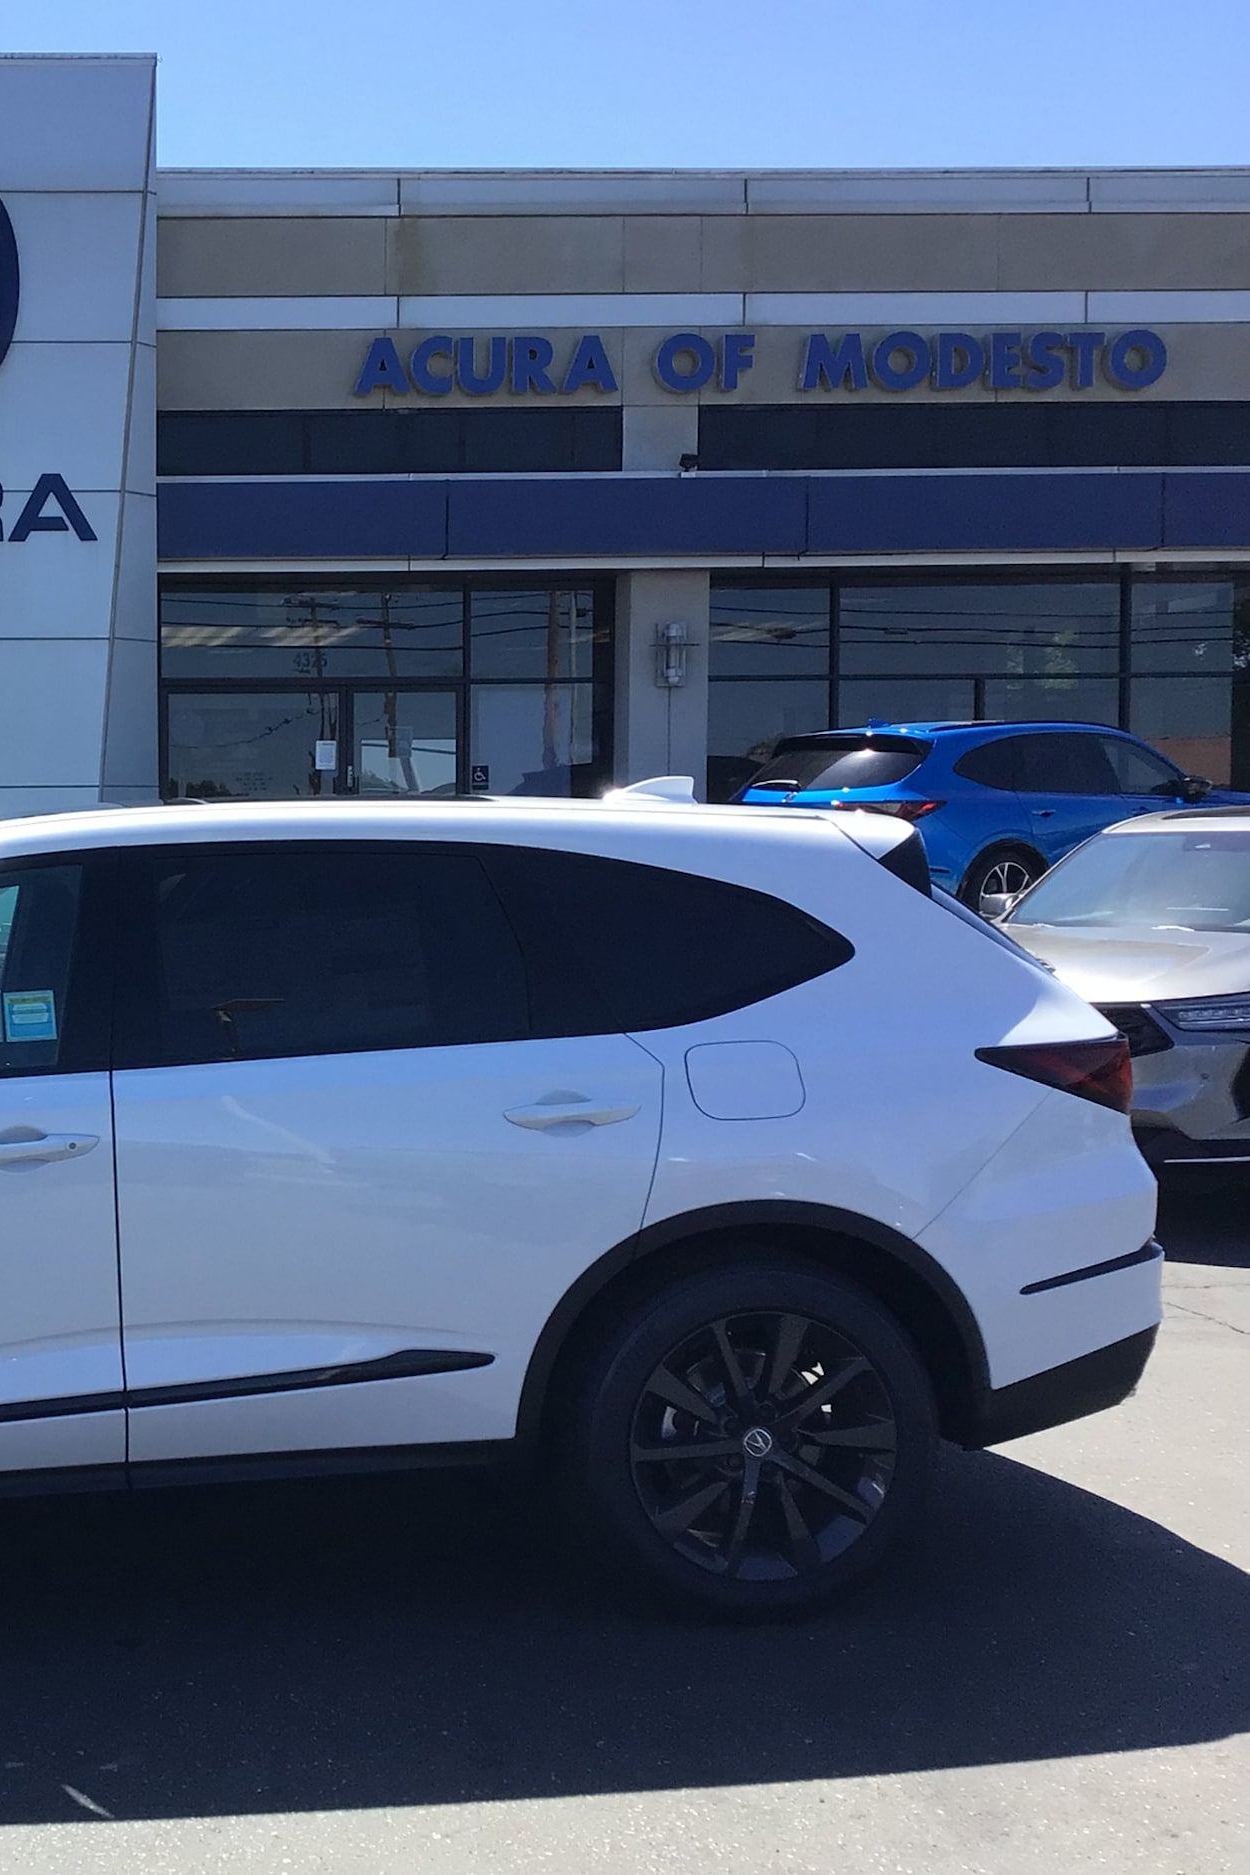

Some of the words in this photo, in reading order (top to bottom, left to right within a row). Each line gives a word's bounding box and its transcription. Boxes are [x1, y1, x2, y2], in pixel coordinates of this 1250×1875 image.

[356, 334, 617, 396] ACURA
[654, 331, 755, 393] OF
[796, 329, 1169, 393] MODESTO
